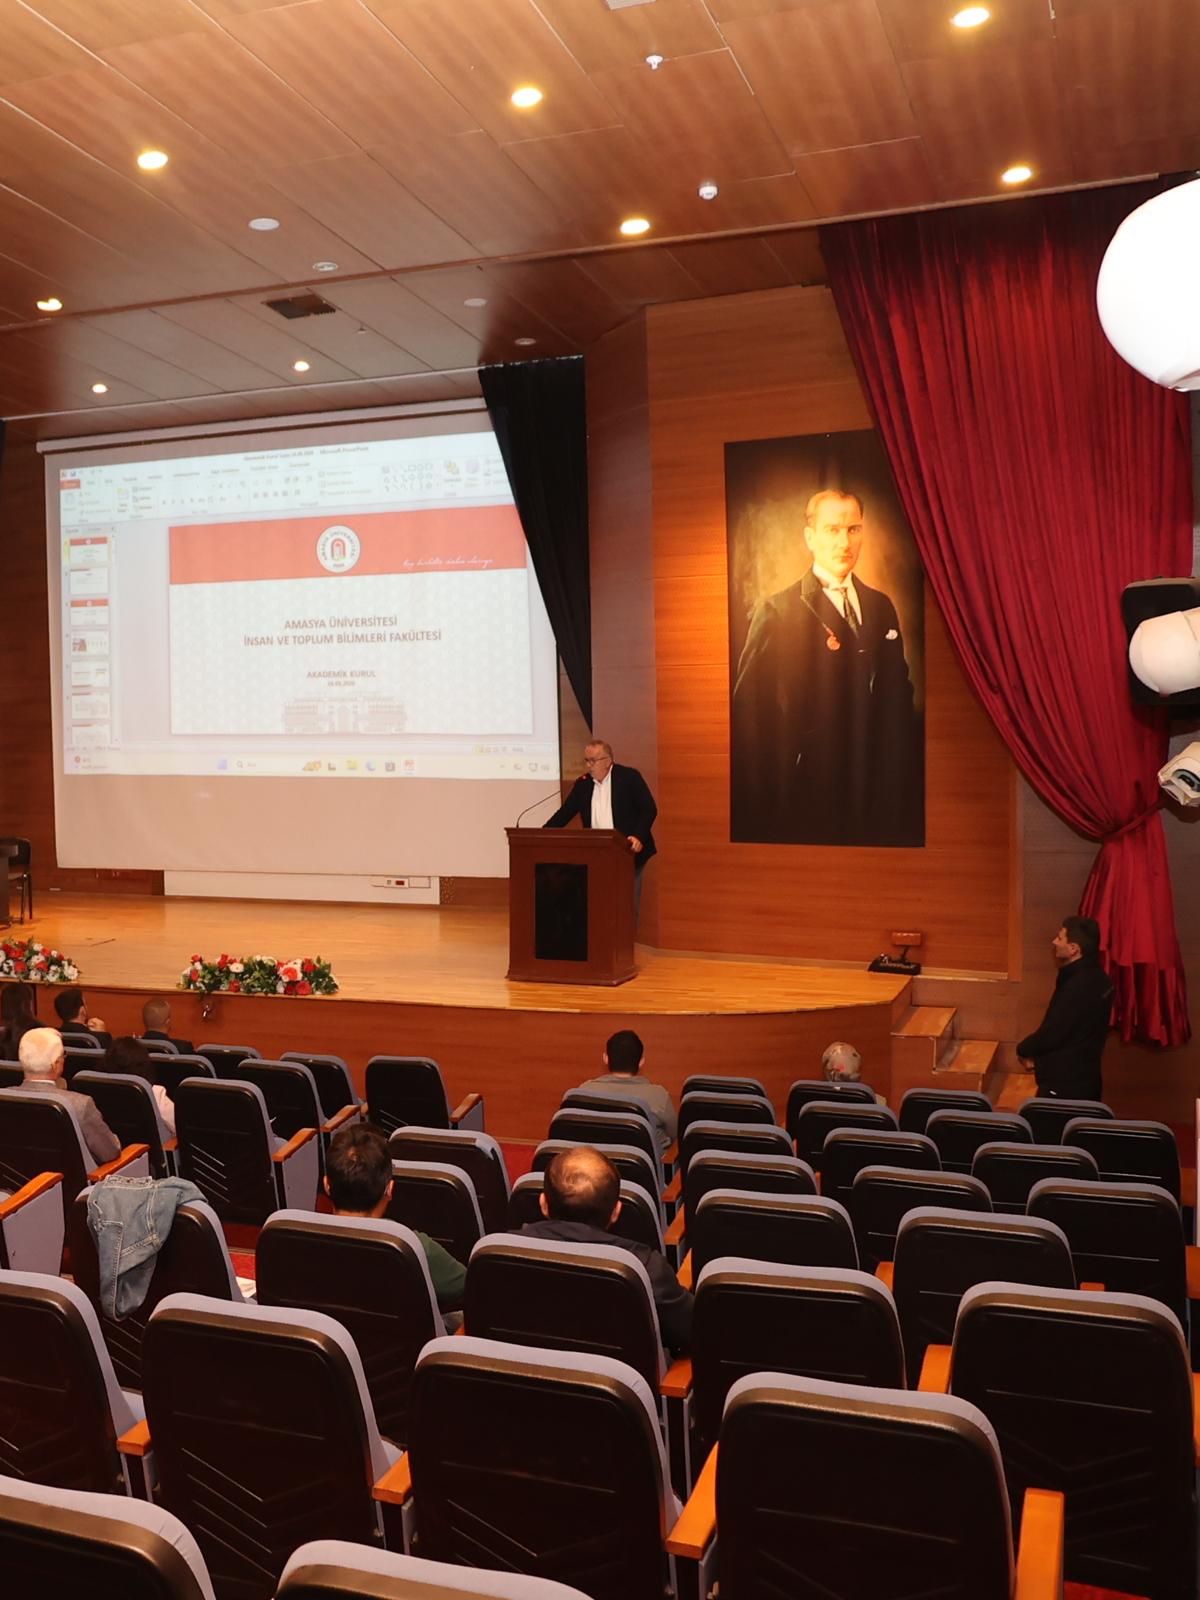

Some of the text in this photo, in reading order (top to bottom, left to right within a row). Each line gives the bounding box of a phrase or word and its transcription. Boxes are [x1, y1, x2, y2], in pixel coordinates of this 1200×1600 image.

[284, 614, 398, 629] AMASYA ÜNİVERSİTESİ
[244, 628, 442, 646] İNSAN VE TOPLUM BİLİMLERİ FAKÜLTESİ
[306, 668, 377, 679] AKADEMİK KURUL
